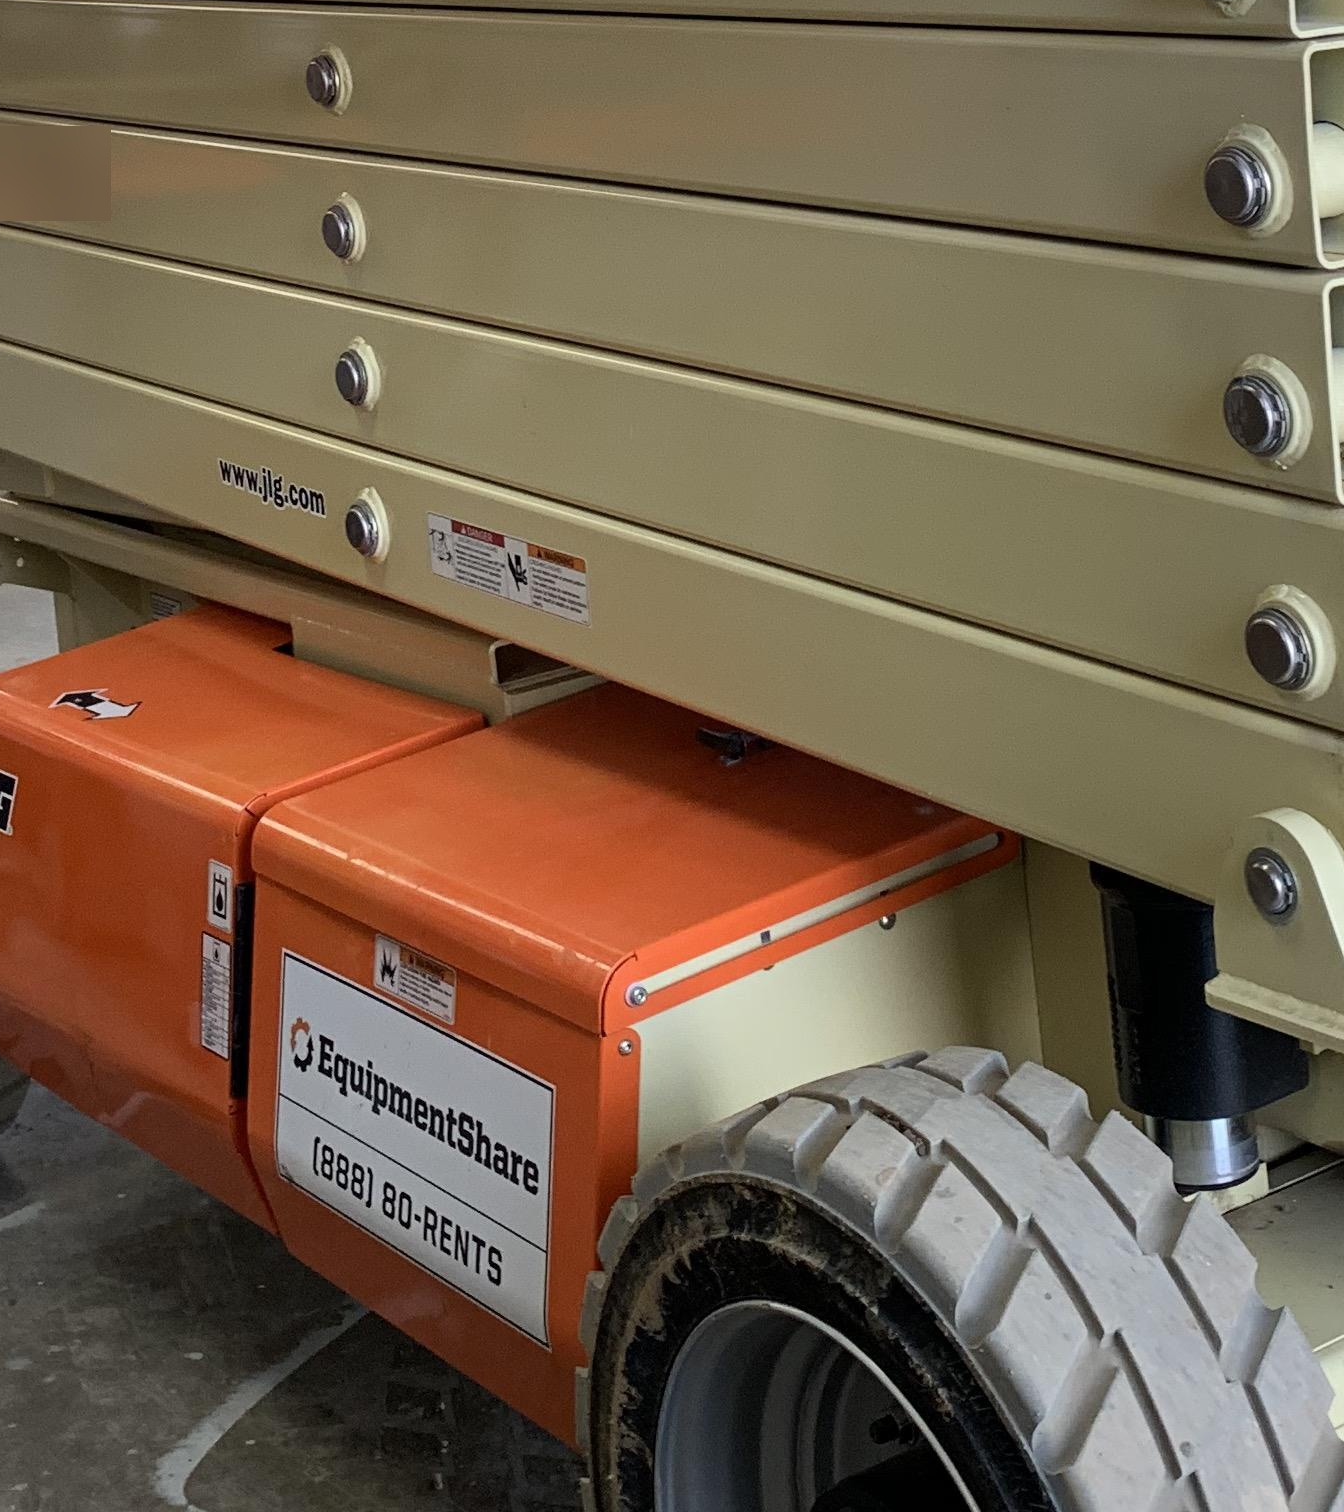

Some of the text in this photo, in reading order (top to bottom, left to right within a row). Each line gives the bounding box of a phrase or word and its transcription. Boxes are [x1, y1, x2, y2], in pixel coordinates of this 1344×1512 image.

[218, 458, 326, 517] www.jlg.com
[317, 1034, 539, 1196] EquipmentShare
[312, 1136, 503, 1287] (888) 80-RENTS
